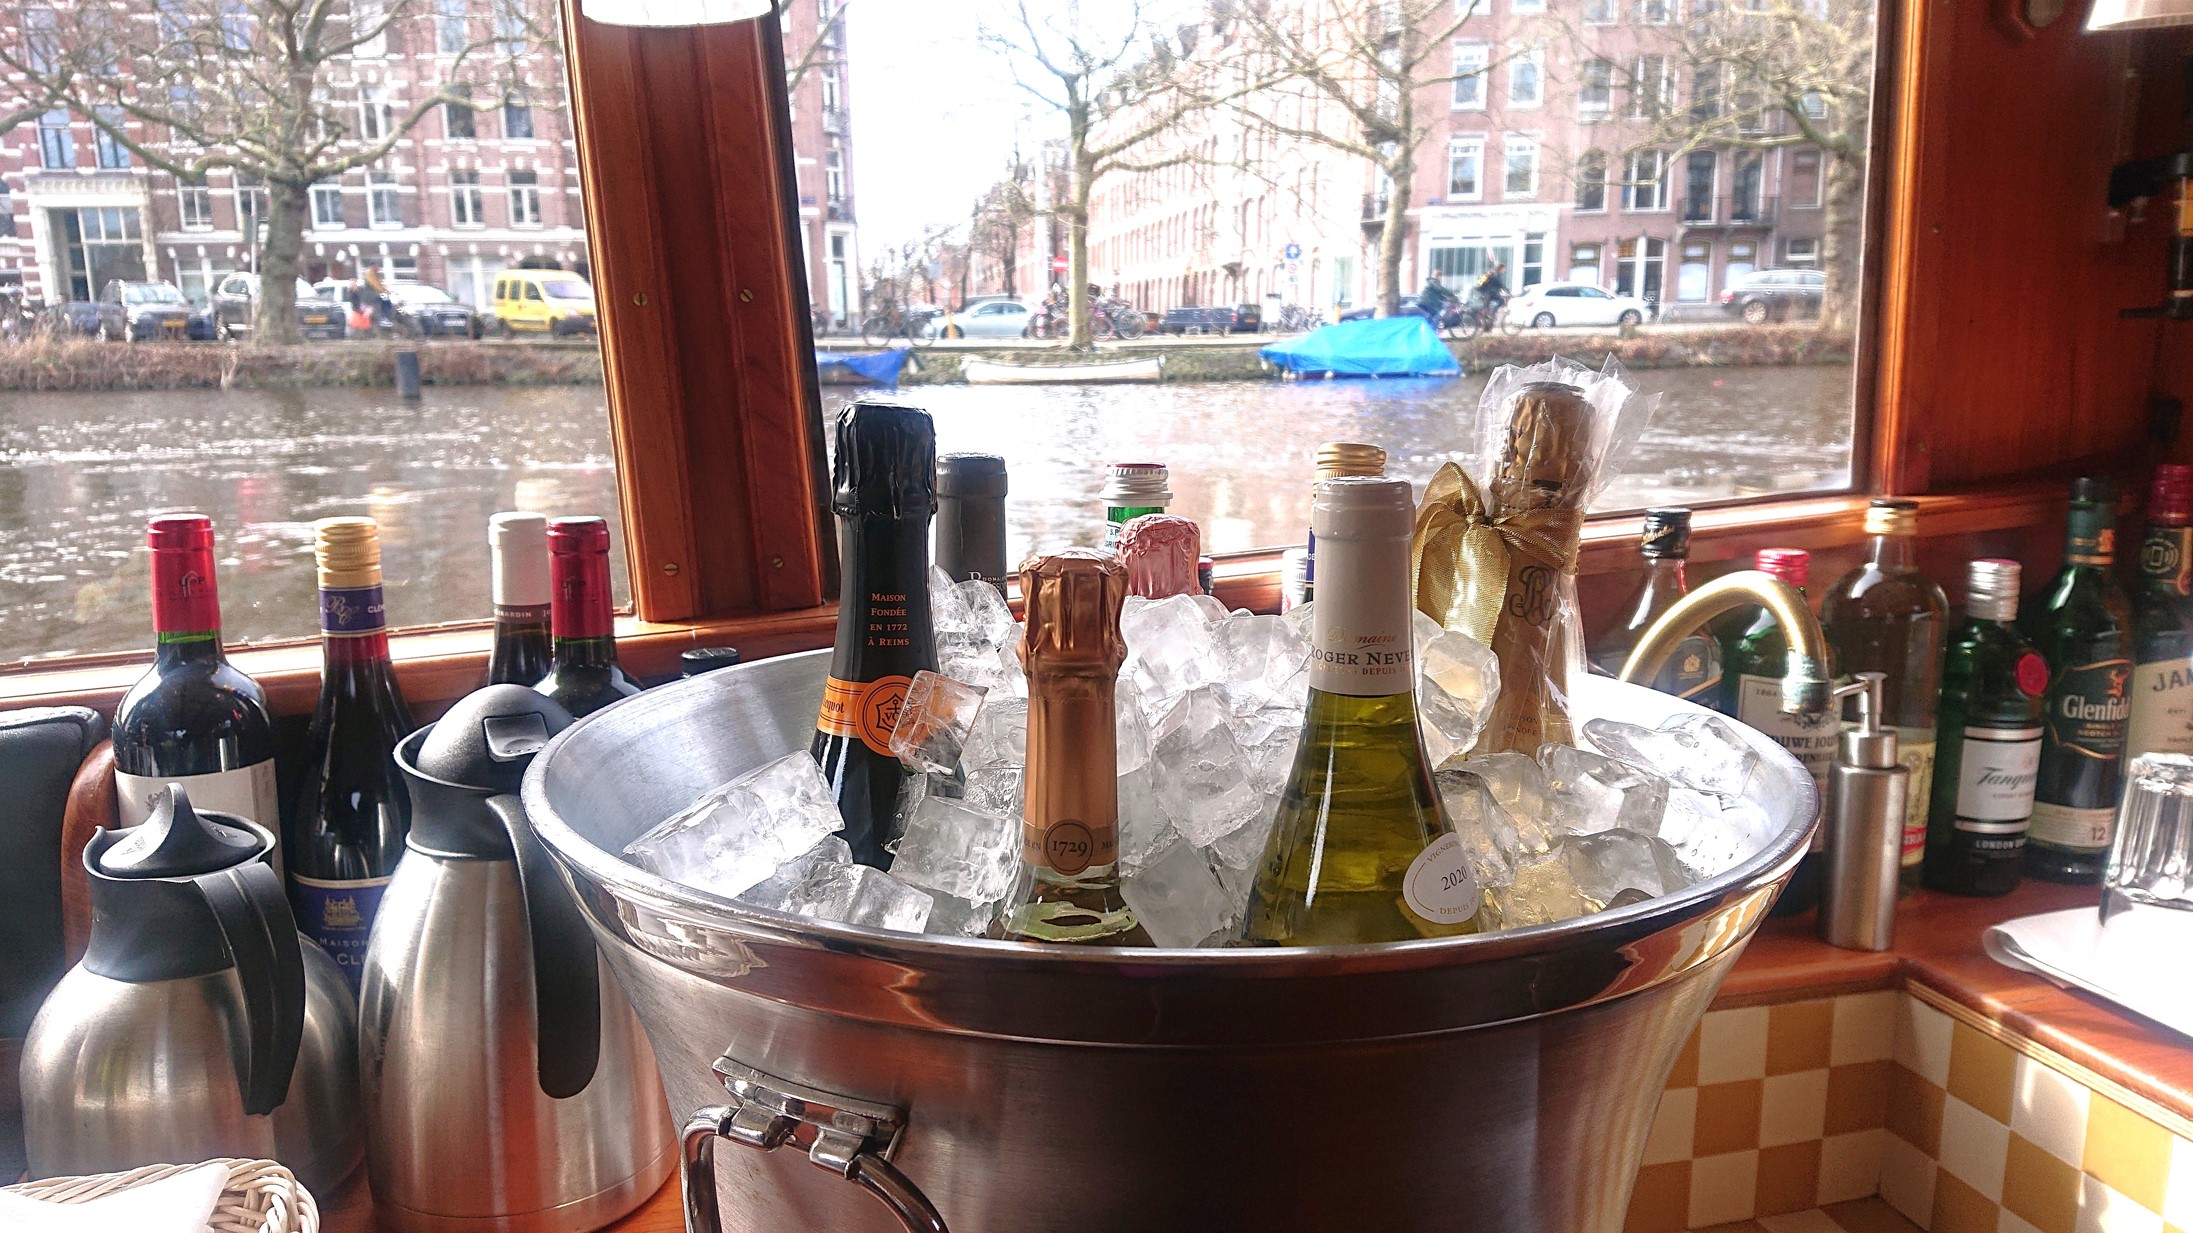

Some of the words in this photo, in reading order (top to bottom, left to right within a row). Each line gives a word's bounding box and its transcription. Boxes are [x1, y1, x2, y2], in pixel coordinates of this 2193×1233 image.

[871, 593, 906, 602] MAISON
[870, 606, 907, 617] FONDÉE
[870, 623, 883, 631] EN
[886, 623, 908, 631] 1772
[868, 636, 875, 646] À
[879, 637, 910, 646] REIMS
[1311, 644, 1360, 666] ROGER
[2091, 827, 2106, 841] 12
[1052, 841, 1088, 857] 1729
[1975, 840, 2015, 850] LONDON
[1441, 865, 1468, 892] 2020
